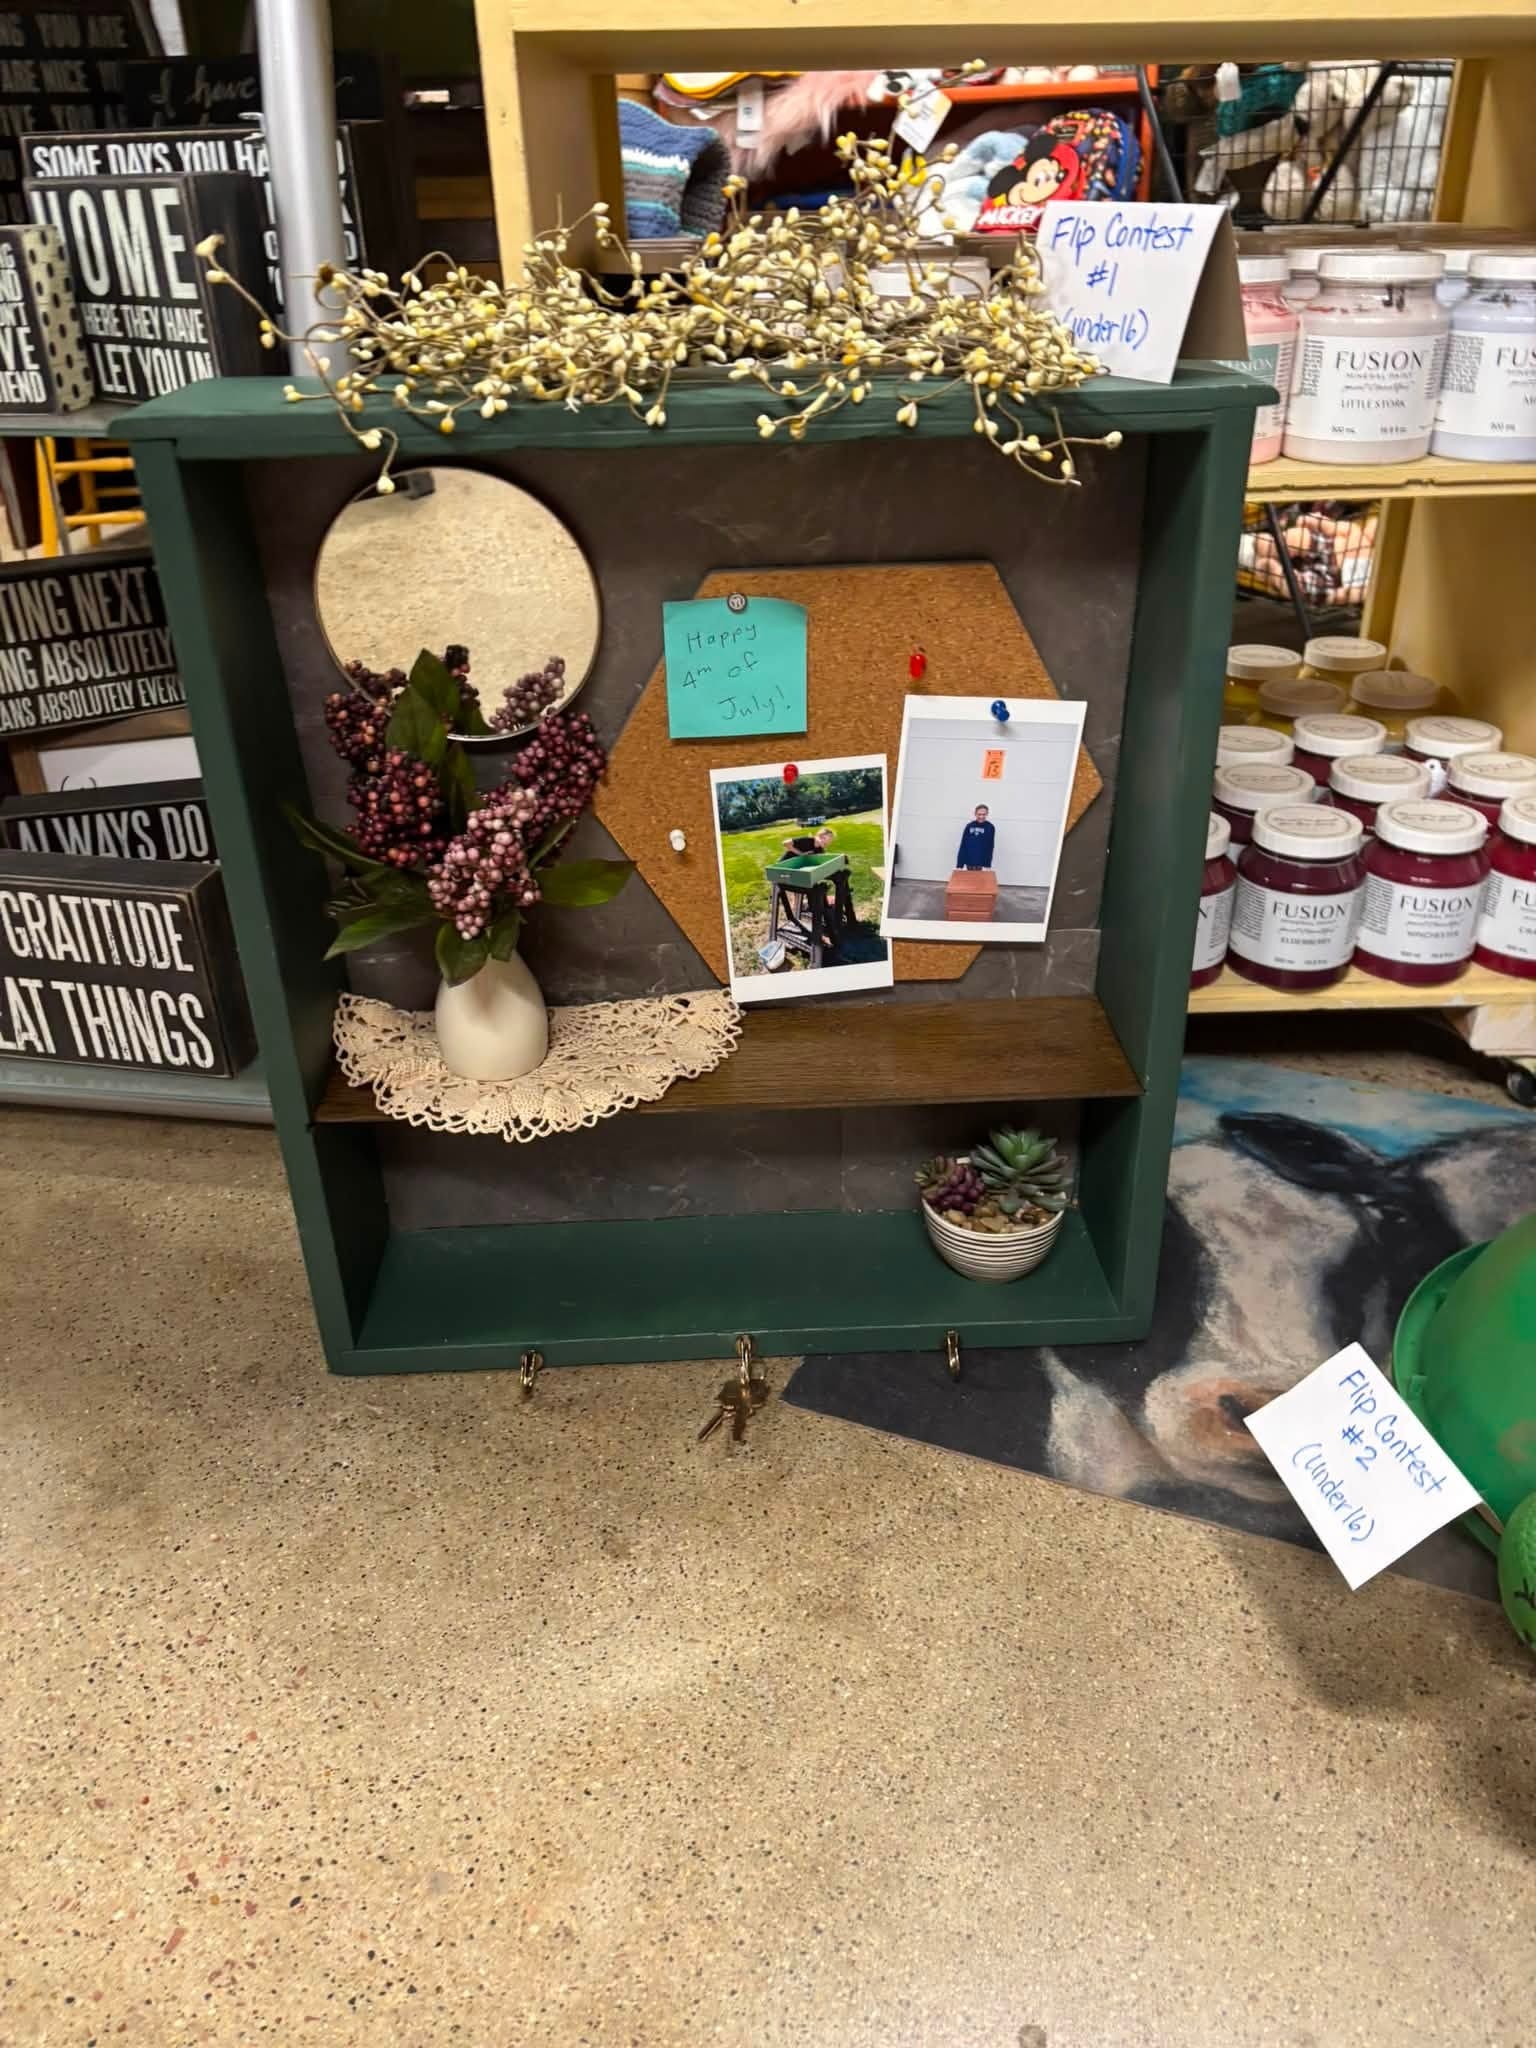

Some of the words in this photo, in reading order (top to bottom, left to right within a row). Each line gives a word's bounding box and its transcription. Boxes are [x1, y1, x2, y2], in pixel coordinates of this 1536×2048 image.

[32, 144, 101, 177] SOME
[106, 142, 171, 175] DAYS
[175, 140, 229, 173] YOU
[1051, 216, 1096, 266] Flip
[1104, 211, 1193, 252] Contest
[1085, 259, 1119, 297] #1
[119, 304, 161, 340] THEY
[161, 306, 209, 344] HAVE
[92, 342, 137, 395] LET
[134, 345, 187, 397] YOU
[1335, 350, 1423, 372] FUSION
[68, 565, 153, 635] NEXT
[39, 625, 175, 689] ABSOLUTELY
[687, 623, 757, 653] Happy
[727, 650, 760, 679] of
[37, 678, 136, 724] ABSOLUTELY
[717, 684, 792, 723] July!
[17, 809, 158, 861] ALWAYS
[158, 804, 209, 861] DO
[1272, 900, 1346, 919] FUSION
[1400, 895, 1473, 913] FUSION
[0, 889, 195, 972] GRATITUDE
[50, 980, 216, 1069] THINGS
[1338, 1368, 1377, 1416] Flip
[1374, 1413, 1448, 1495] Contest
